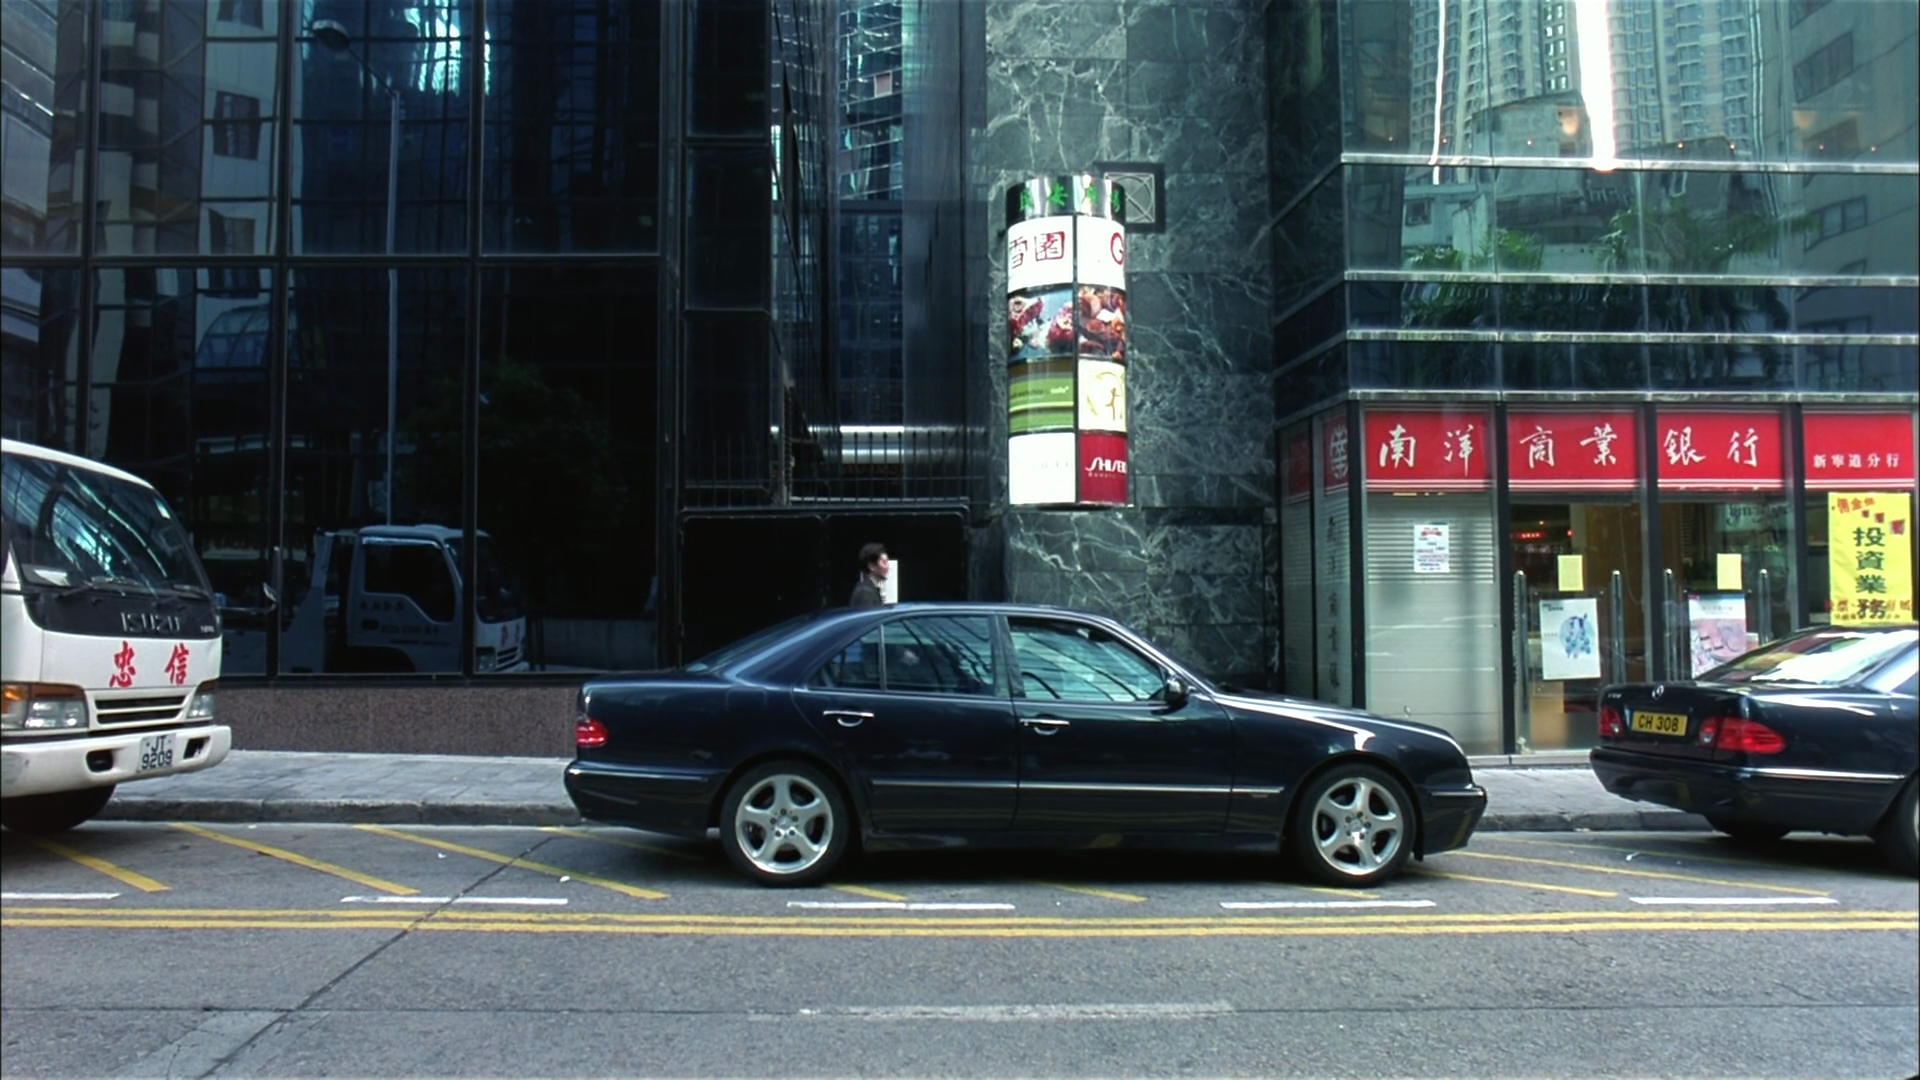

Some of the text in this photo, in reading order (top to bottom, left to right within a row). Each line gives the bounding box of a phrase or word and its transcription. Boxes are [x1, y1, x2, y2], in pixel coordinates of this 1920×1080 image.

[1379, 423, 1760, 477] 南洋商業銀行
[1852, 526, 1887, 620] 投資業務
[120, 612, 181, 633] ISUZU
[109, 640, 190, 688] 忠信
[1638, 714, 1680, 733] CH 308
[151, 734, 168, 752] JT
[141, 749, 173, 770] 9209
